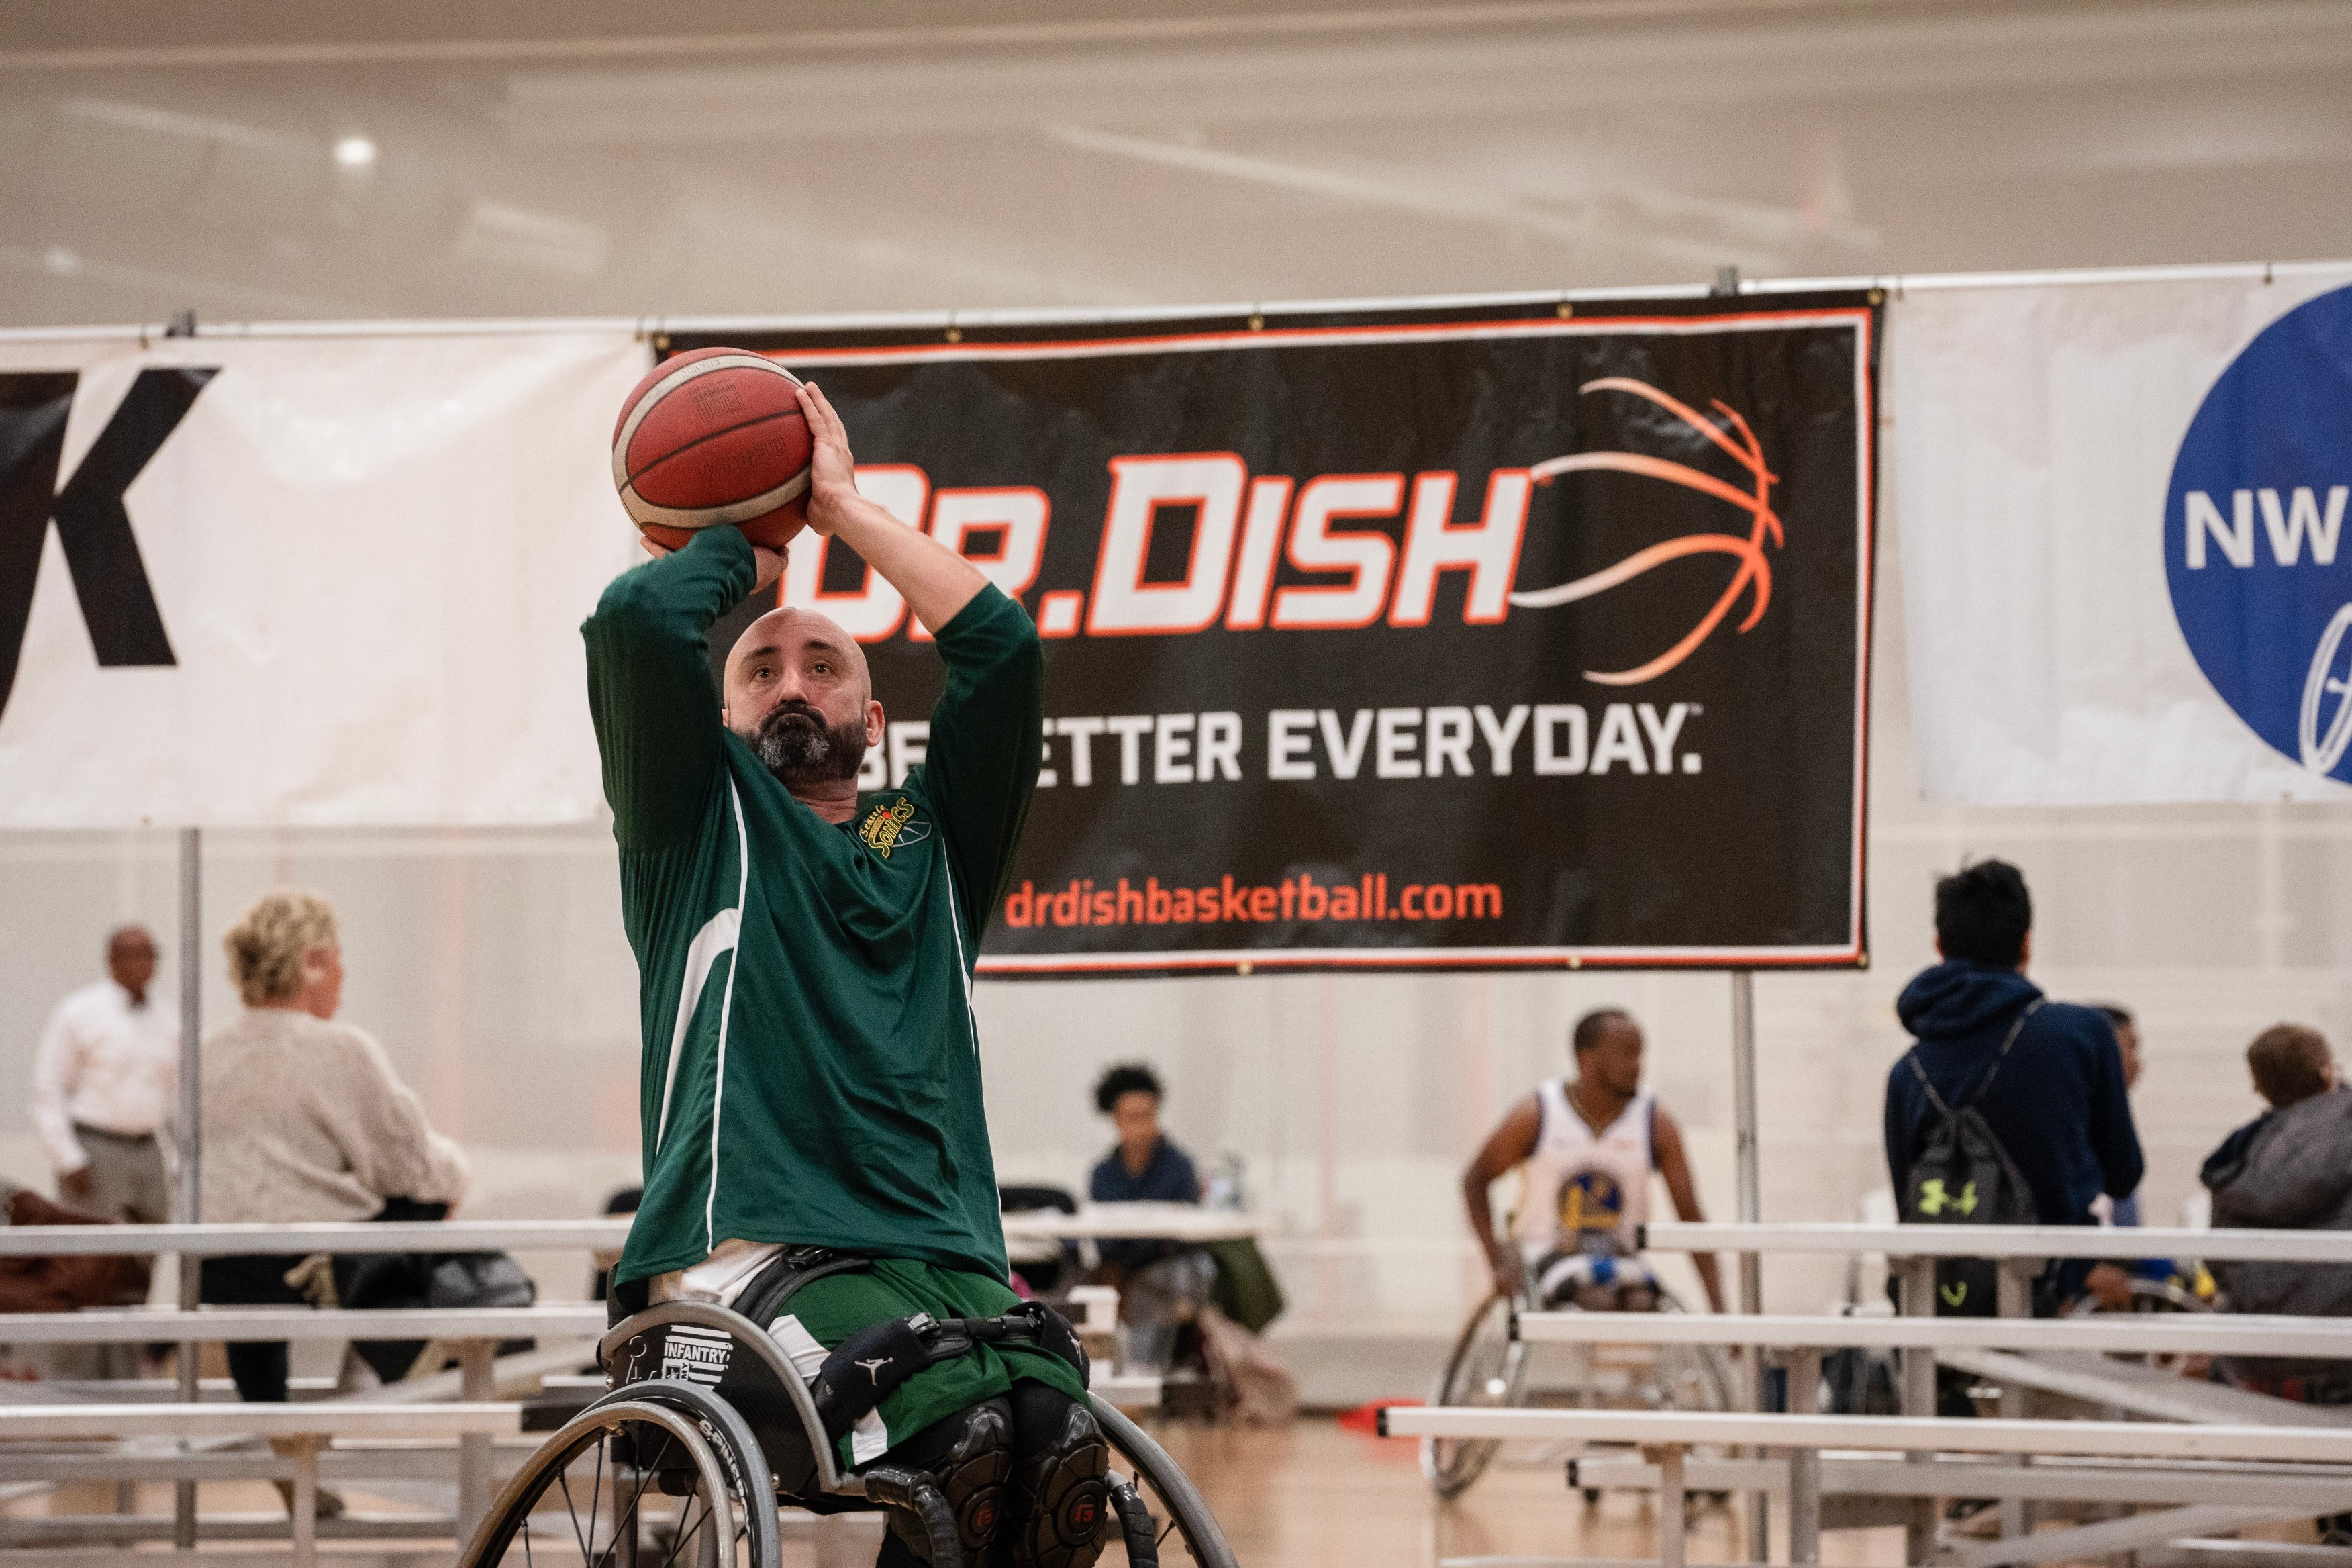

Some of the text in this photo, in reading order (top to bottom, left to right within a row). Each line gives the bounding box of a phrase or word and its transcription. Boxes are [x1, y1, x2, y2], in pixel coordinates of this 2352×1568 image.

[696, 391, 745, 424] FIBA
[1036, 711, 1242, 788] TTER
[860, 805, 886, 838] Seattle
[868, 797, 915, 859] SONICS
[1005, 873, 1503, 928] drdishbasketball.com
[664, 1342, 728, 1365] INFANTRY
